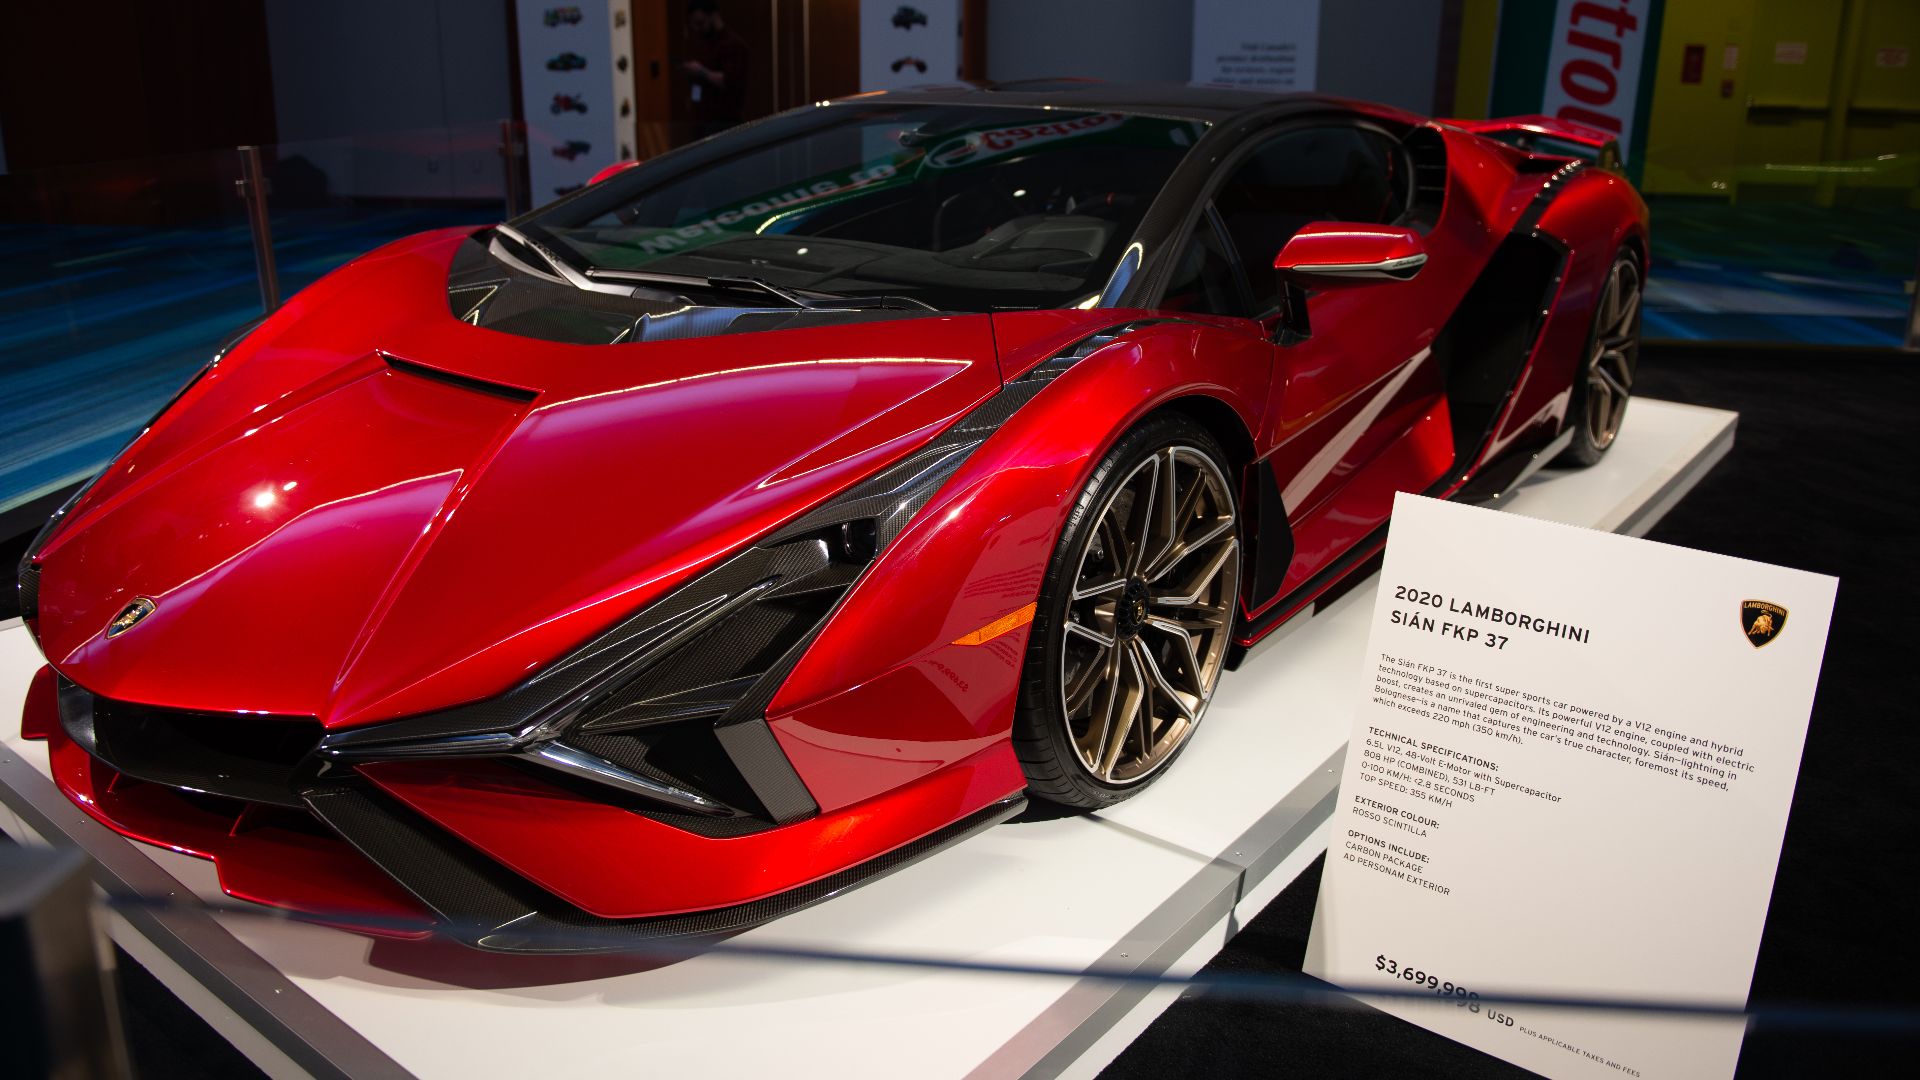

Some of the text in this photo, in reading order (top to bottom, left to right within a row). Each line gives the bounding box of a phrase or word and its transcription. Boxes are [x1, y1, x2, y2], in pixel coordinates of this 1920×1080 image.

[1557, 0, 1637, 134] trol
[1390, 610, 1509, 650] SIÁN FKP 37
[1394, 585, 1590, 644] 2020 LAMBORGHINI
[1373, 696, 1524, 745] which exceeds 220 mph (350 km/h).
[1376, 674, 1401, 688] boost,
[1403, 683, 1434, 697] creates
[1435, 692, 1446, 700] an
[1448, 695, 1488, 712] unrivaled
[1489, 706, 1508, 717] gem
[1510, 712, 1520, 720] of
[1521, 715, 1575, 737] engineering
[1576, 730, 1595, 741] and
[1596, 734, 1651, 758] technology.
[1727, 770, 1737, 781] in
[1378, 664, 1755, 773] technology based on supercapacitors. Its powerful V12 engine, coupled with electric
[1381, 653, 1396, 664] The
[1397, 658, 1416, 669] Sián
[1417, 663, 1435, 674] FKP
[1436, 668, 1448, 677] 37
[1449, 671, 1457, 680] is
[1459, 674, 1473, 685] the
[1475, 678, 1493, 690] first
[1495, 685, 1521, 697] super
[1522, 692, 1551, 706] sports
[1553, 700, 1568, 710] car
[1569, 705, 1610, 722] powered
[1611, 714, 1624, 726] by
[1635, 720, 1652, 733] V12
[1654, 727, 1688, 742] engine
[1689, 737, 1709, 748] and
[1710, 741, 1744, 757] hybrid
[1366, 738, 1562, 803] 6.5L V12, 48-Volt E-Motor with Supercapacitor
[1369, 726, 1499, 772] TECHNICAL SPECIFICATIONS:
[1437, 703, 1461, 715] name
[1463, 710, 1481, 721] that
[1482, 716, 1521, 732] captures
[1523, 726, 1538, 737] the
[1564, 737, 1584, 750] true
[1585, 745, 1632, 765] character,
[1635, 757, 1679, 777] foremost
[1681, 770, 1694, 781] its
[1696, 776, 1729, 792] speed,
[1360, 772, 1453, 808] TOP SPEED: 355 KM/H
[1363, 749, 1496, 796] 808 HP (COMBINED), 531 LB-FT
[1386, 768, 1412, 783] KM/H:
[1433, 783, 1475, 803] SECONDS
[1352, 806, 1427, 838] ROSSO SCINTILLA
[1354, 795, 1440, 830] EXTERIOR COLOUR:
[1345, 840, 1424, 874] CARBON PACKAGE
[1348, 829, 1430, 864] OPTIONS INCLUDE:
[1343, 852, 1451, 896] AD PERSONAM EXTERIOR
[1487, 1008, 1514, 1027] USD
[1519, 1026, 1537, 1038] PLUS
[1538, 1034, 1581, 1055] APPLICABLE
[1582, 1050, 1604, 1064] TAXES
[1605, 1060, 1621, 1070] AND
[1622, 1066, 1640, 1078] FEES
